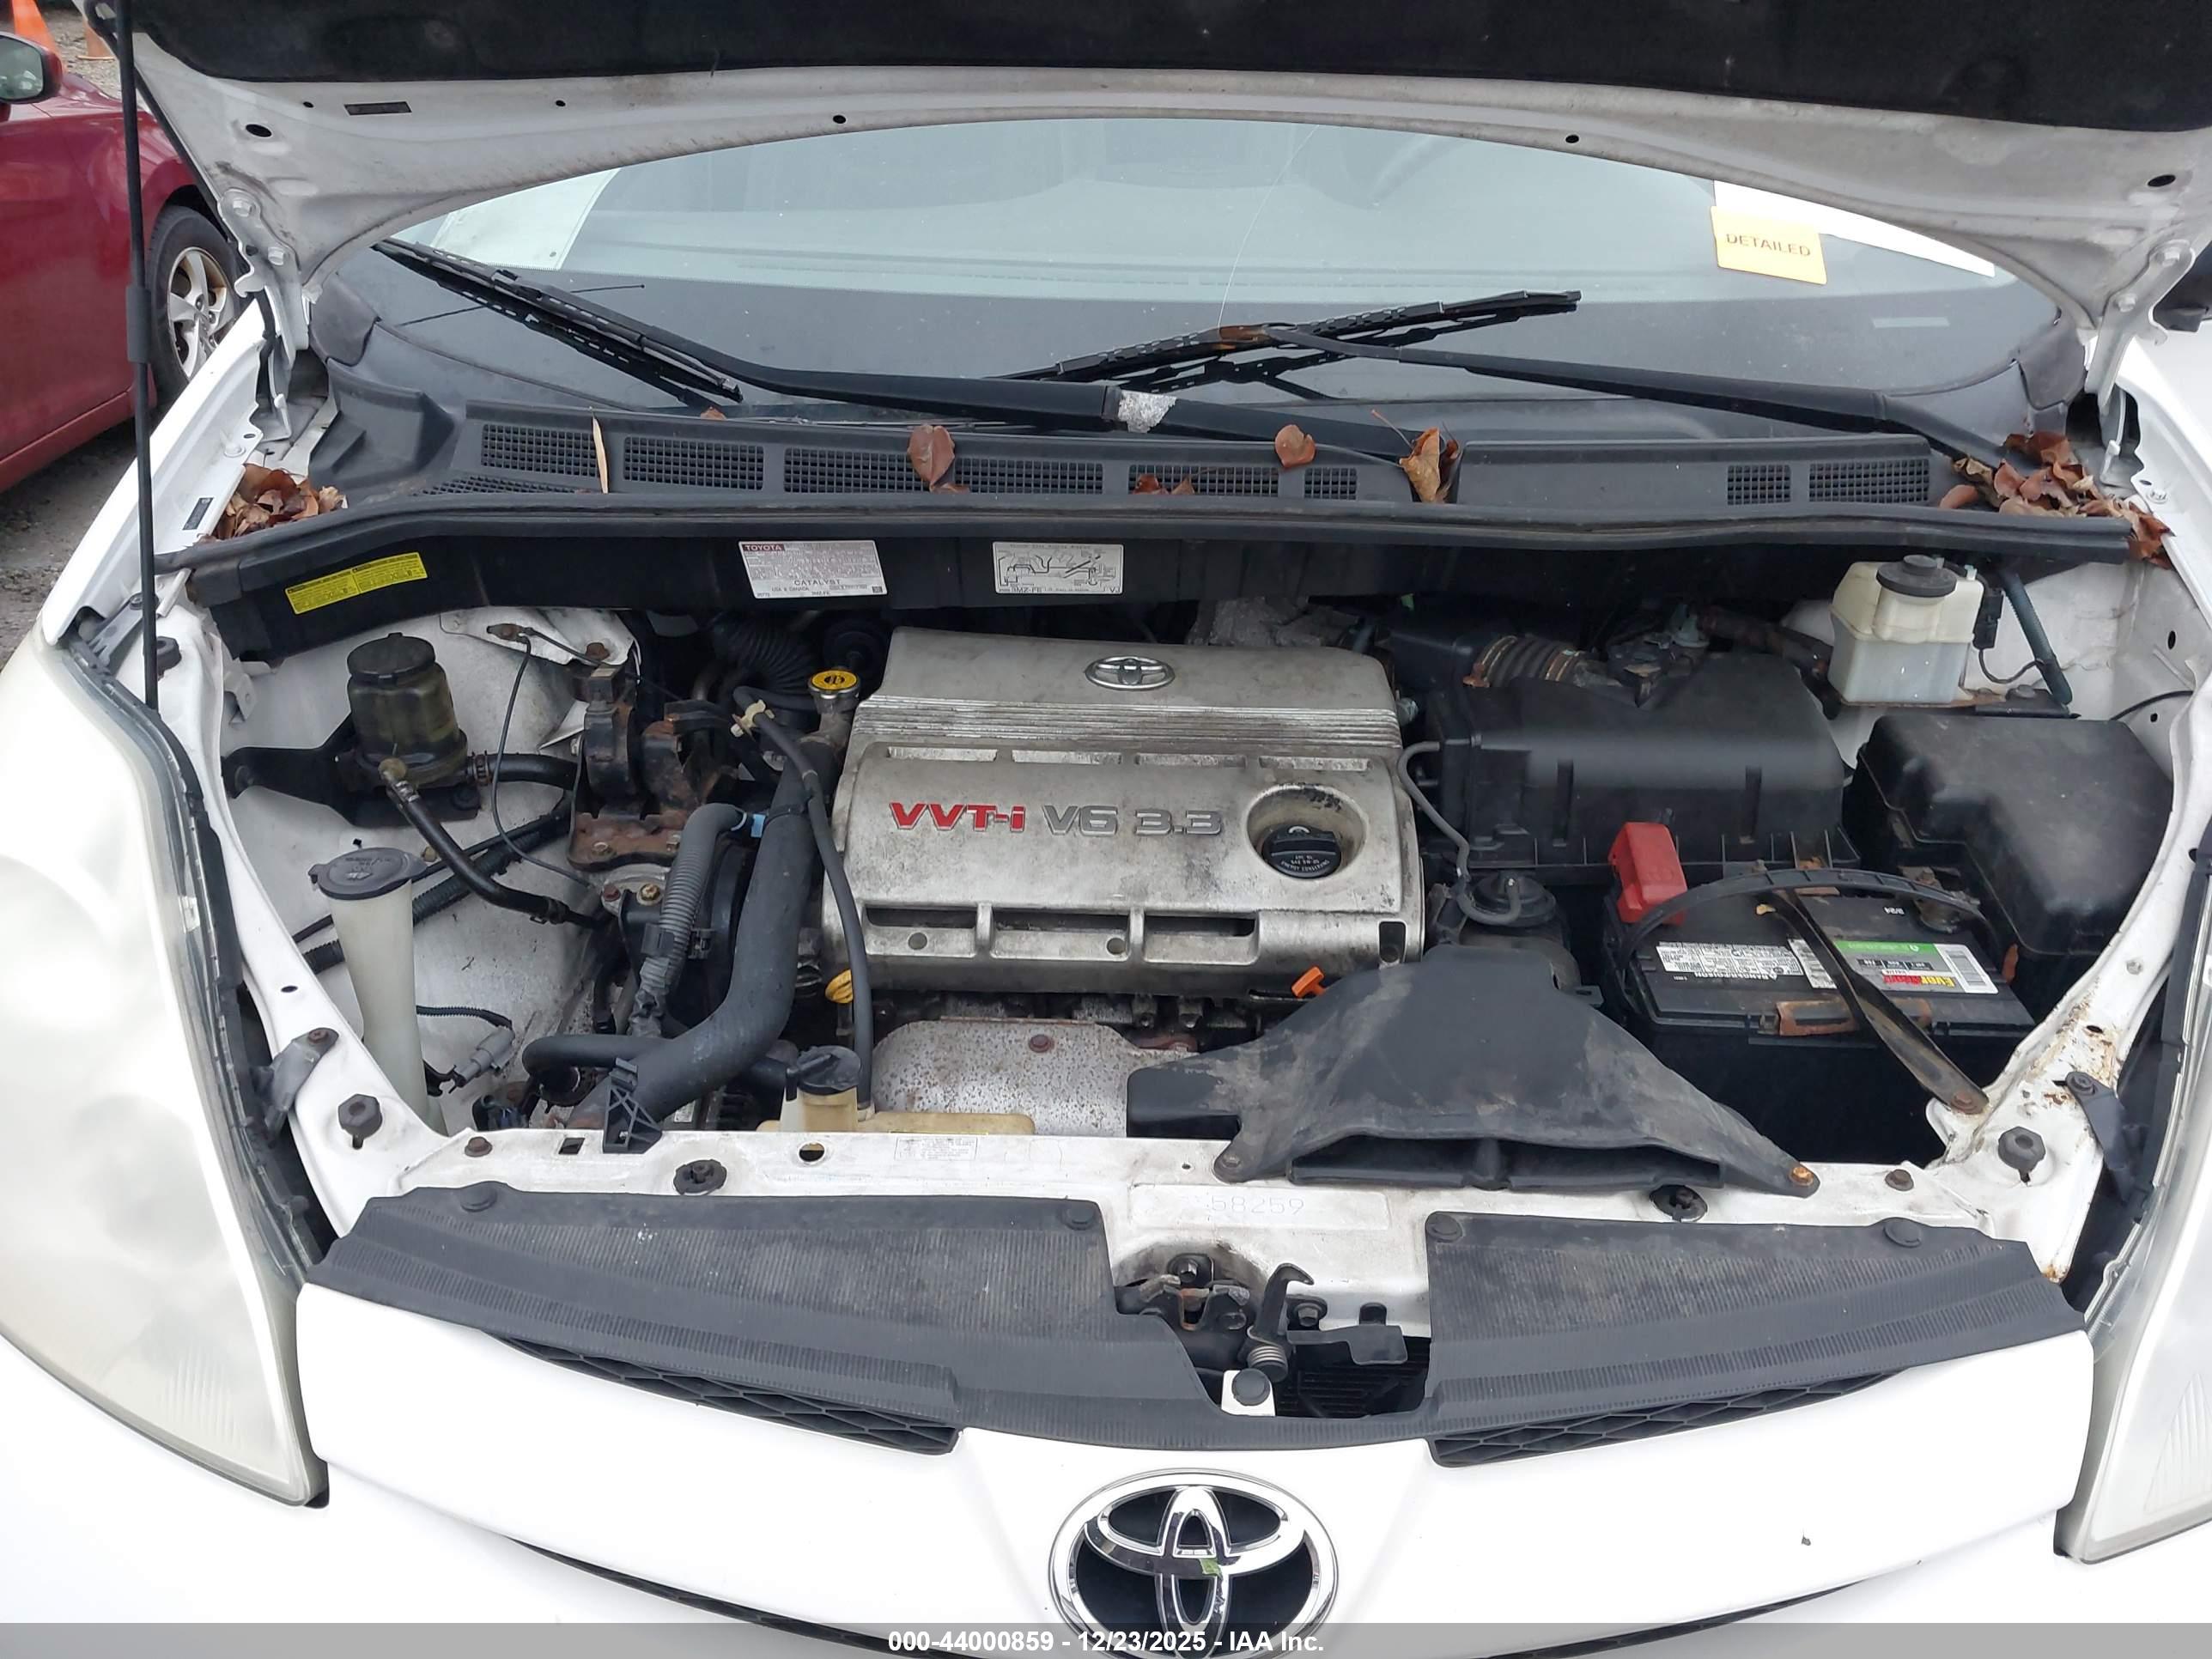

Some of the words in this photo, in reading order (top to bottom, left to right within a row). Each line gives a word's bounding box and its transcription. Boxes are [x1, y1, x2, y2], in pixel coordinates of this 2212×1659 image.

[1726, 233, 1811, 257] DETAILED
[890, 802, 1026, 833] VVT-i
[1043, 805, 1118, 836] V6
[1134, 808, 1223, 836] 3.3
[1211, 1194, 1305, 1215] 58259
